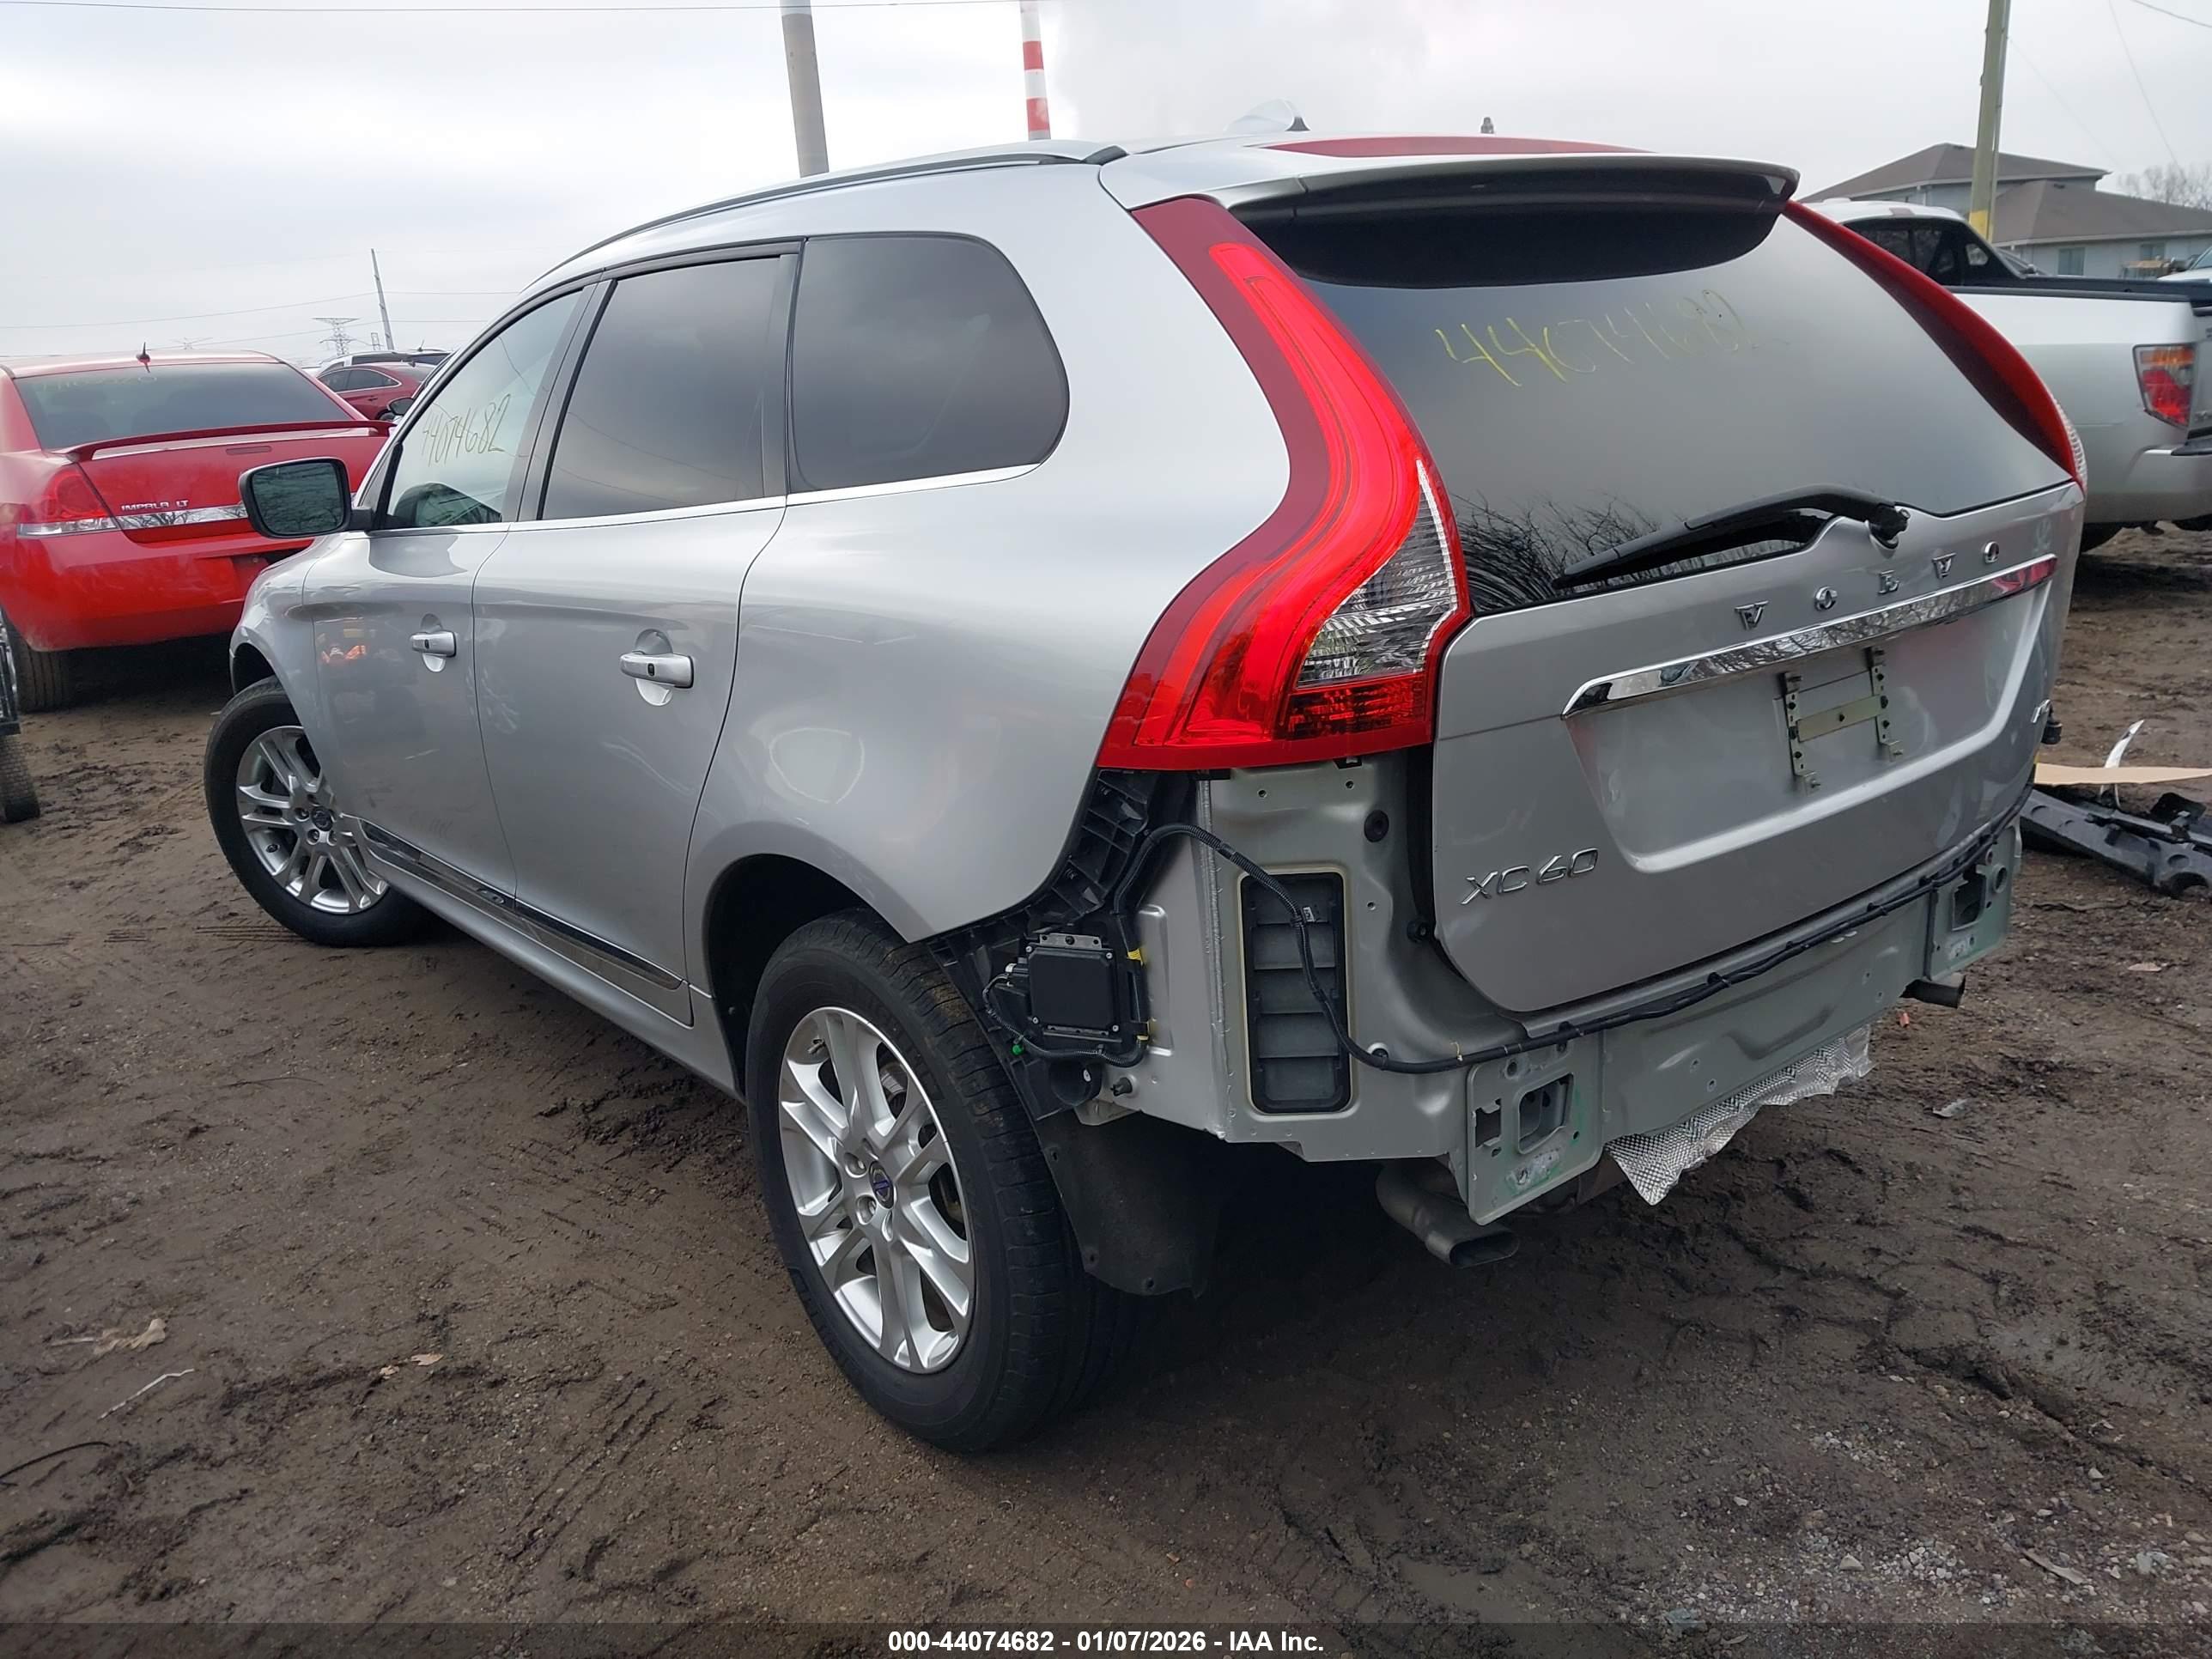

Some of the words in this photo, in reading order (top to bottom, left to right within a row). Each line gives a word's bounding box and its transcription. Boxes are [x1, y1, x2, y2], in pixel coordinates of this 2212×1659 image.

[121, 501, 170, 512] IMPALA
[1735, 540, 2000, 631] VOLVO
[1460, 847, 1599, 905] XC60
